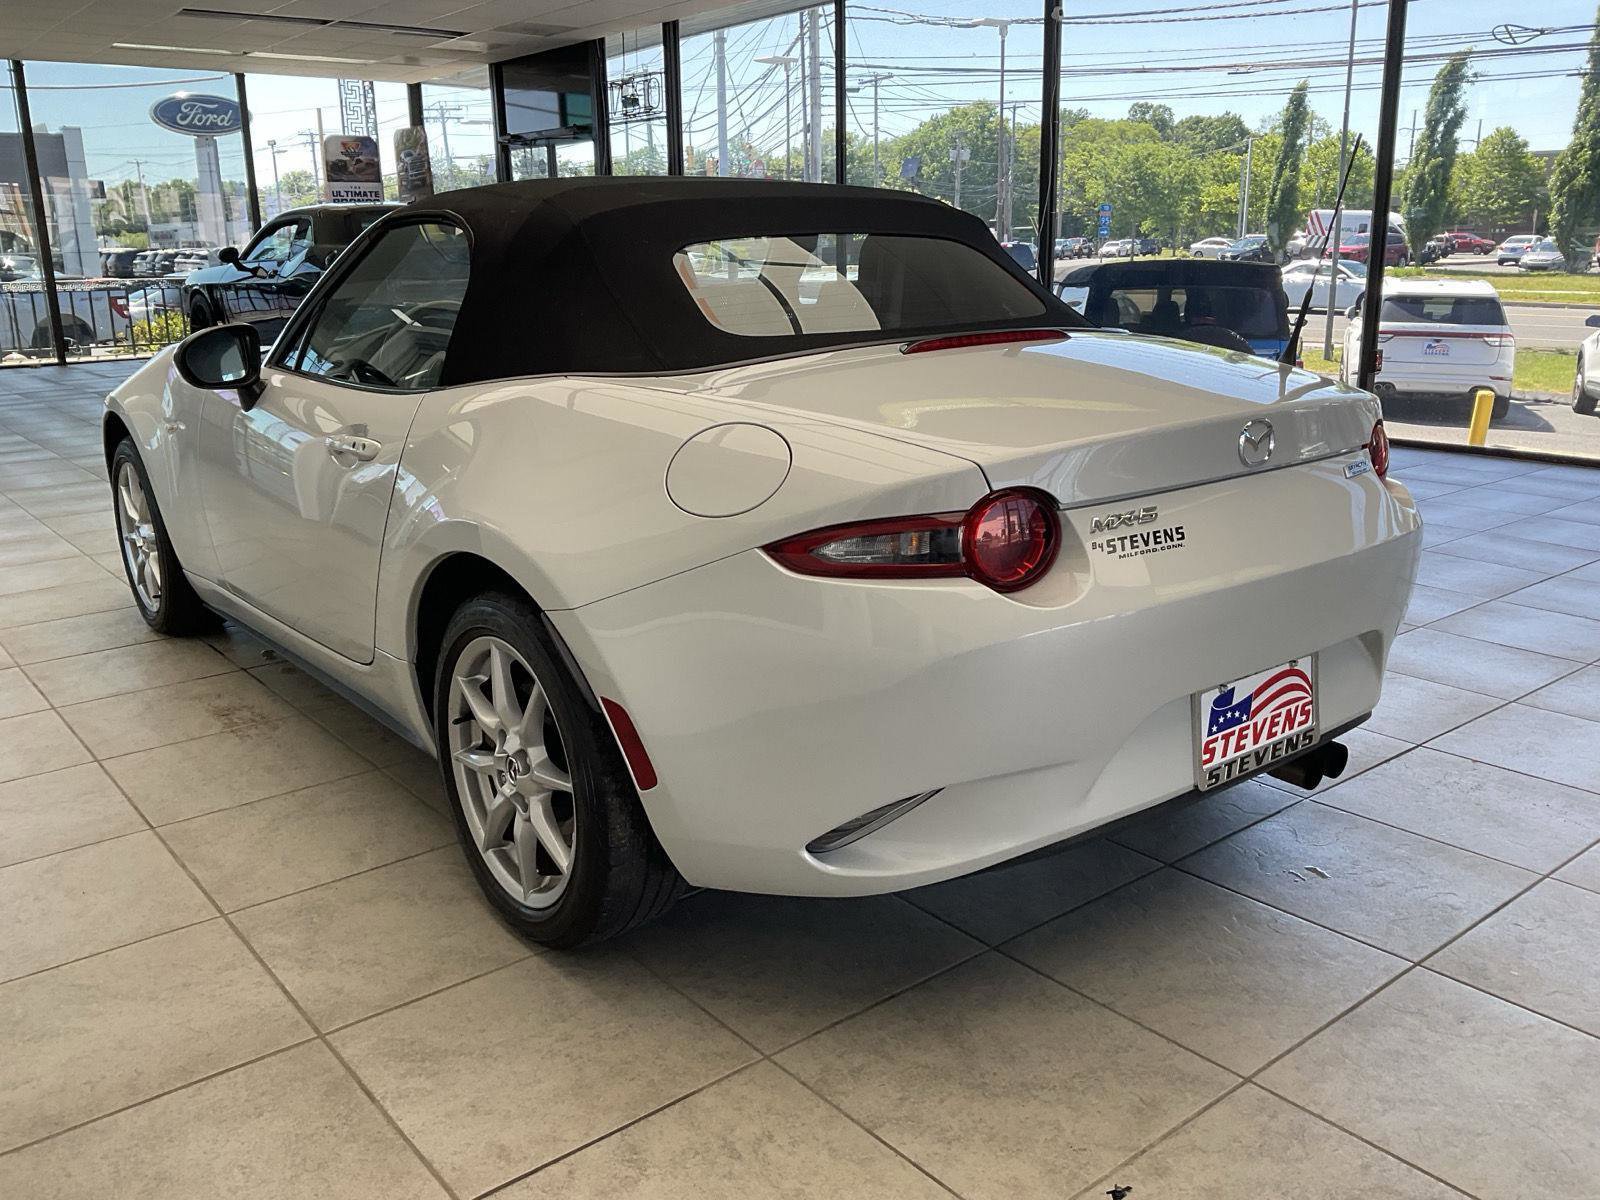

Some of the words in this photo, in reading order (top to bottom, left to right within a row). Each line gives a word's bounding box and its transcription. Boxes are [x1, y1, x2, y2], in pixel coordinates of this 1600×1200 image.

[176, 101, 233, 126] Ford
[331, 190, 381, 198] ULTIMATE
[1089, 505, 1159, 535] MX-5
[1105, 525, 1186, 555] STEVENS
[1202, 699, 1313, 766] STEVENS
[1206, 727, 1315, 788] STEVENS
